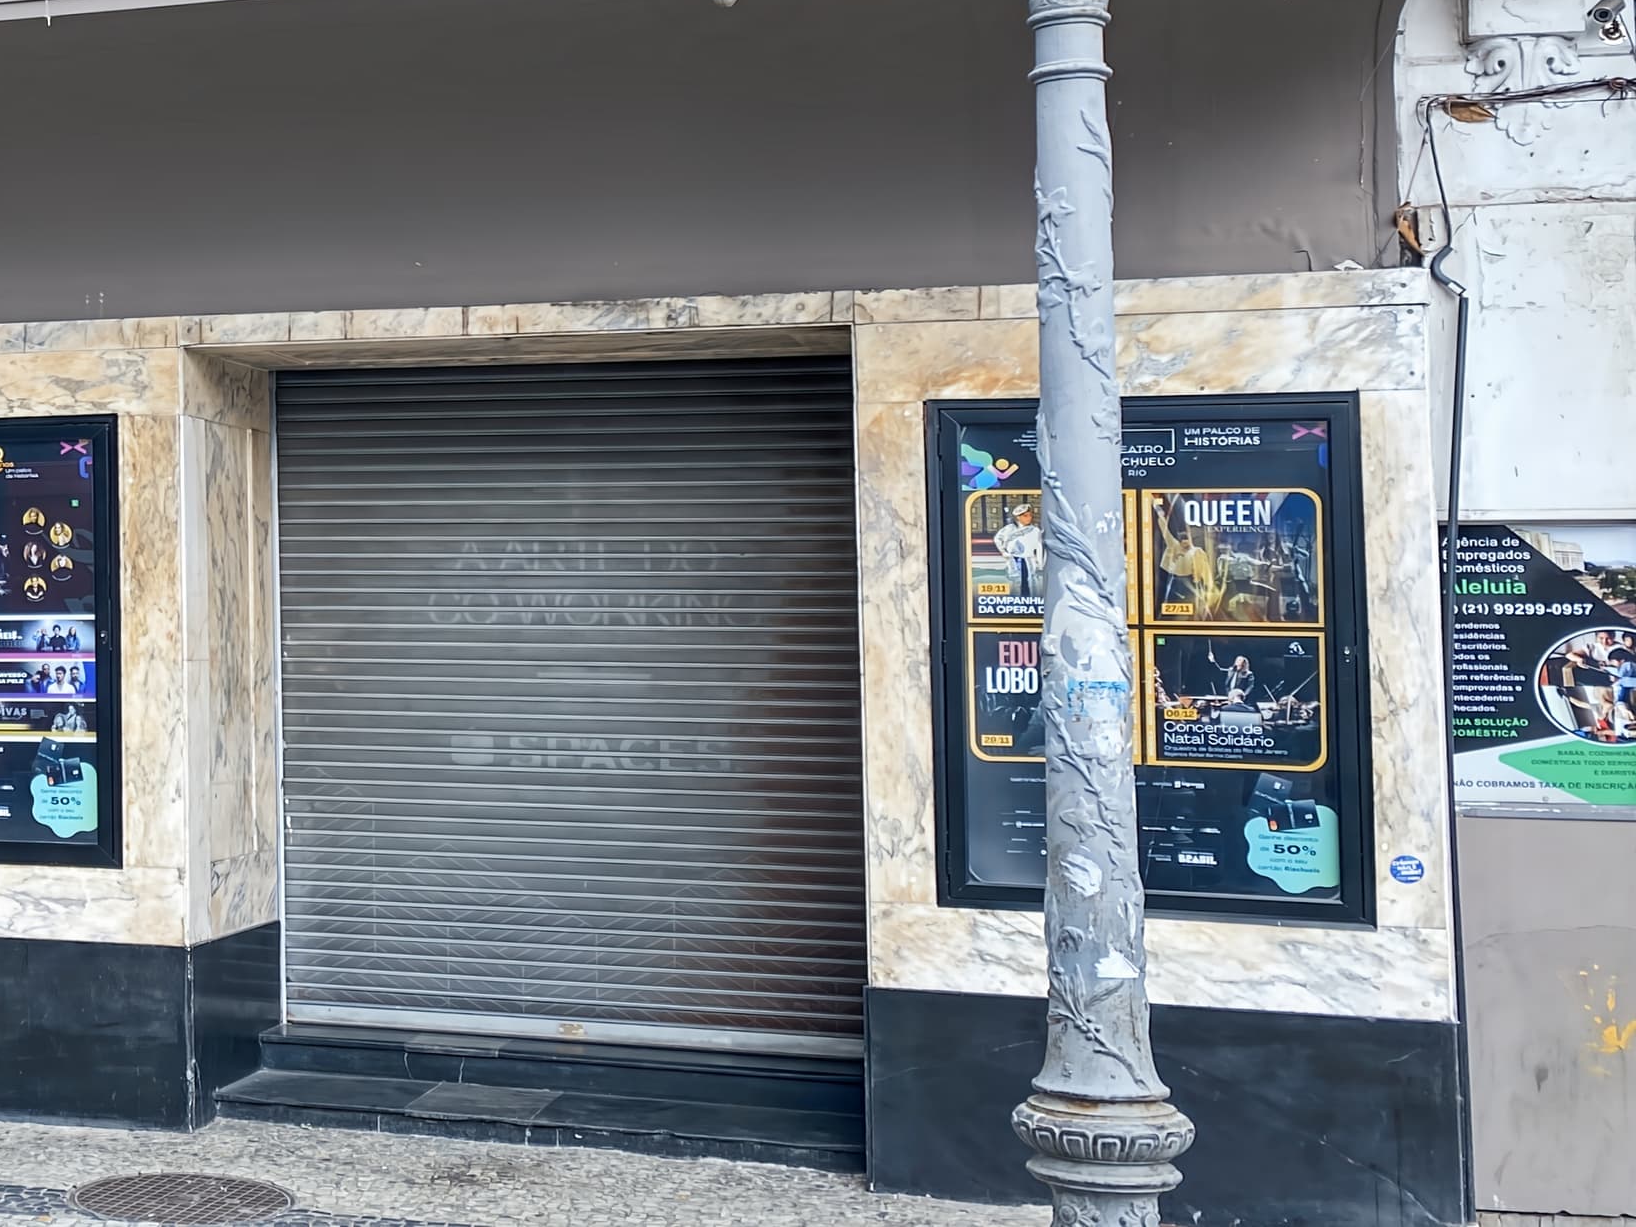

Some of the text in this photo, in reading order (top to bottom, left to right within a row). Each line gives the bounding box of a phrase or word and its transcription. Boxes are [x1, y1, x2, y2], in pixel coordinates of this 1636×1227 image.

[1184, 426, 1260, 436] UM PALCO DE
[1184, 435, 1261, 447] HISTÓRIAS
[1121, 445, 1164, 454] EATRO
[1122, 457, 1176, 466] CHUELO
[1184, 500, 1271, 527] QUEEN
[1502, 536, 1520, 547] de
[978, 606, 994, 614] DA
[1164, 604, 1190, 613] 27/11
[1462, 603, 1593, 616] (21) 99299-0957
[998, 640, 1038, 667] EDU
[986, 666, 1039, 694] LOBO
[1452, 684, 1513, 692] omprovadas
[1164, 721, 1263, 735] Concerto de
[1474, 717, 1529, 728] SOLUÇÃO
[1164, 733, 1274, 748] Natal Solidário
[1453, 778, 1473, 788] NÃO
[1476, 780, 1536, 789] COBRAMOS
[1568, 782, 1582, 790] DE
[1585, 781, 1636, 791] INSCRIÇÃ
[50, 796, 82, 806] 50%
[1273, 844, 1317, 856] 50%
